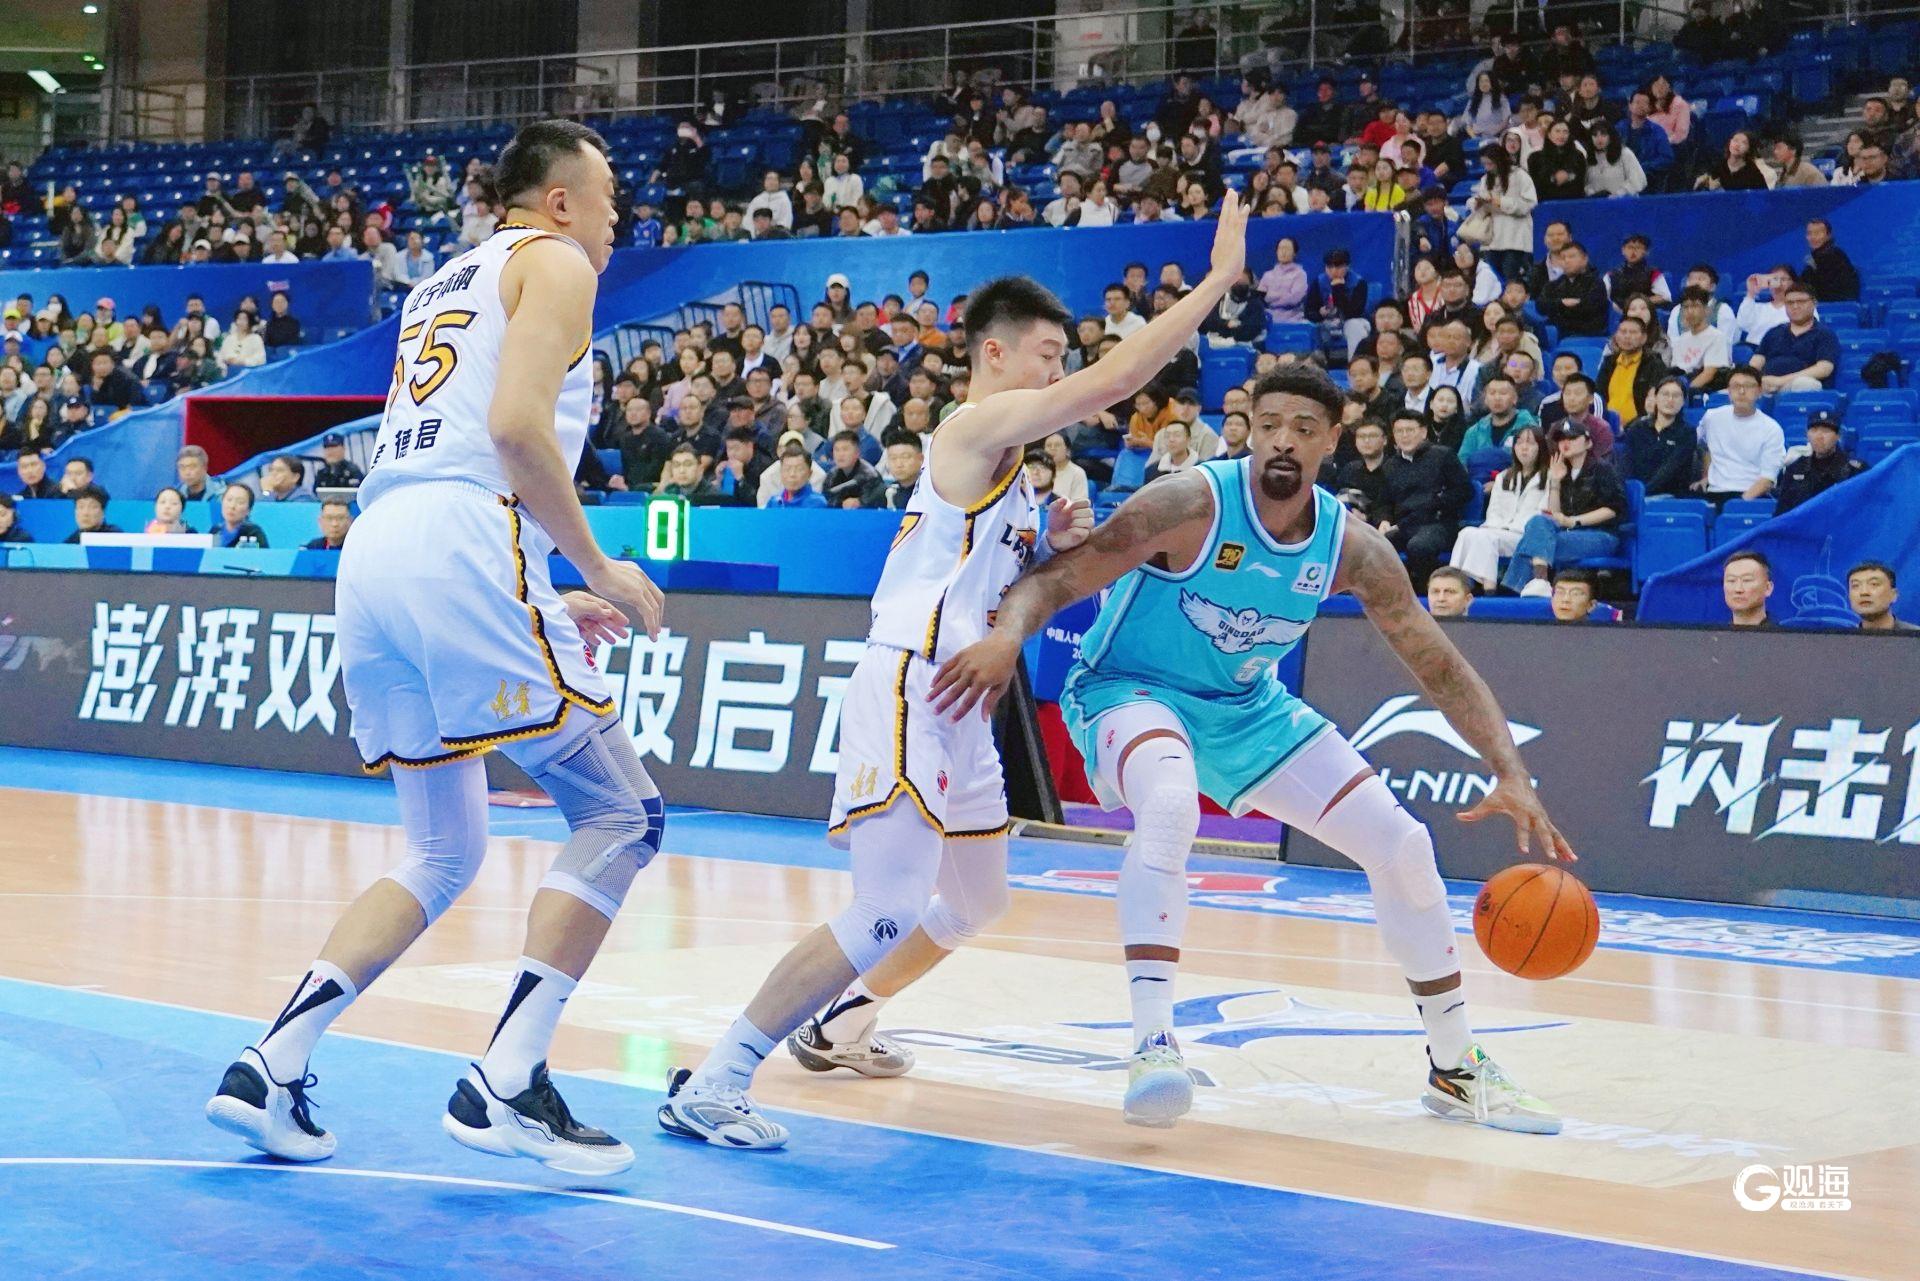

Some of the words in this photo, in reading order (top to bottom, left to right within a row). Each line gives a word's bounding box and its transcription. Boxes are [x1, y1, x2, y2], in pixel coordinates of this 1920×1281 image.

[78, 602, 356, 738] 澎湃双
[1218, 620, 1266, 638] QINGDAO
[1639, 713, 1920, 846] 闪击
